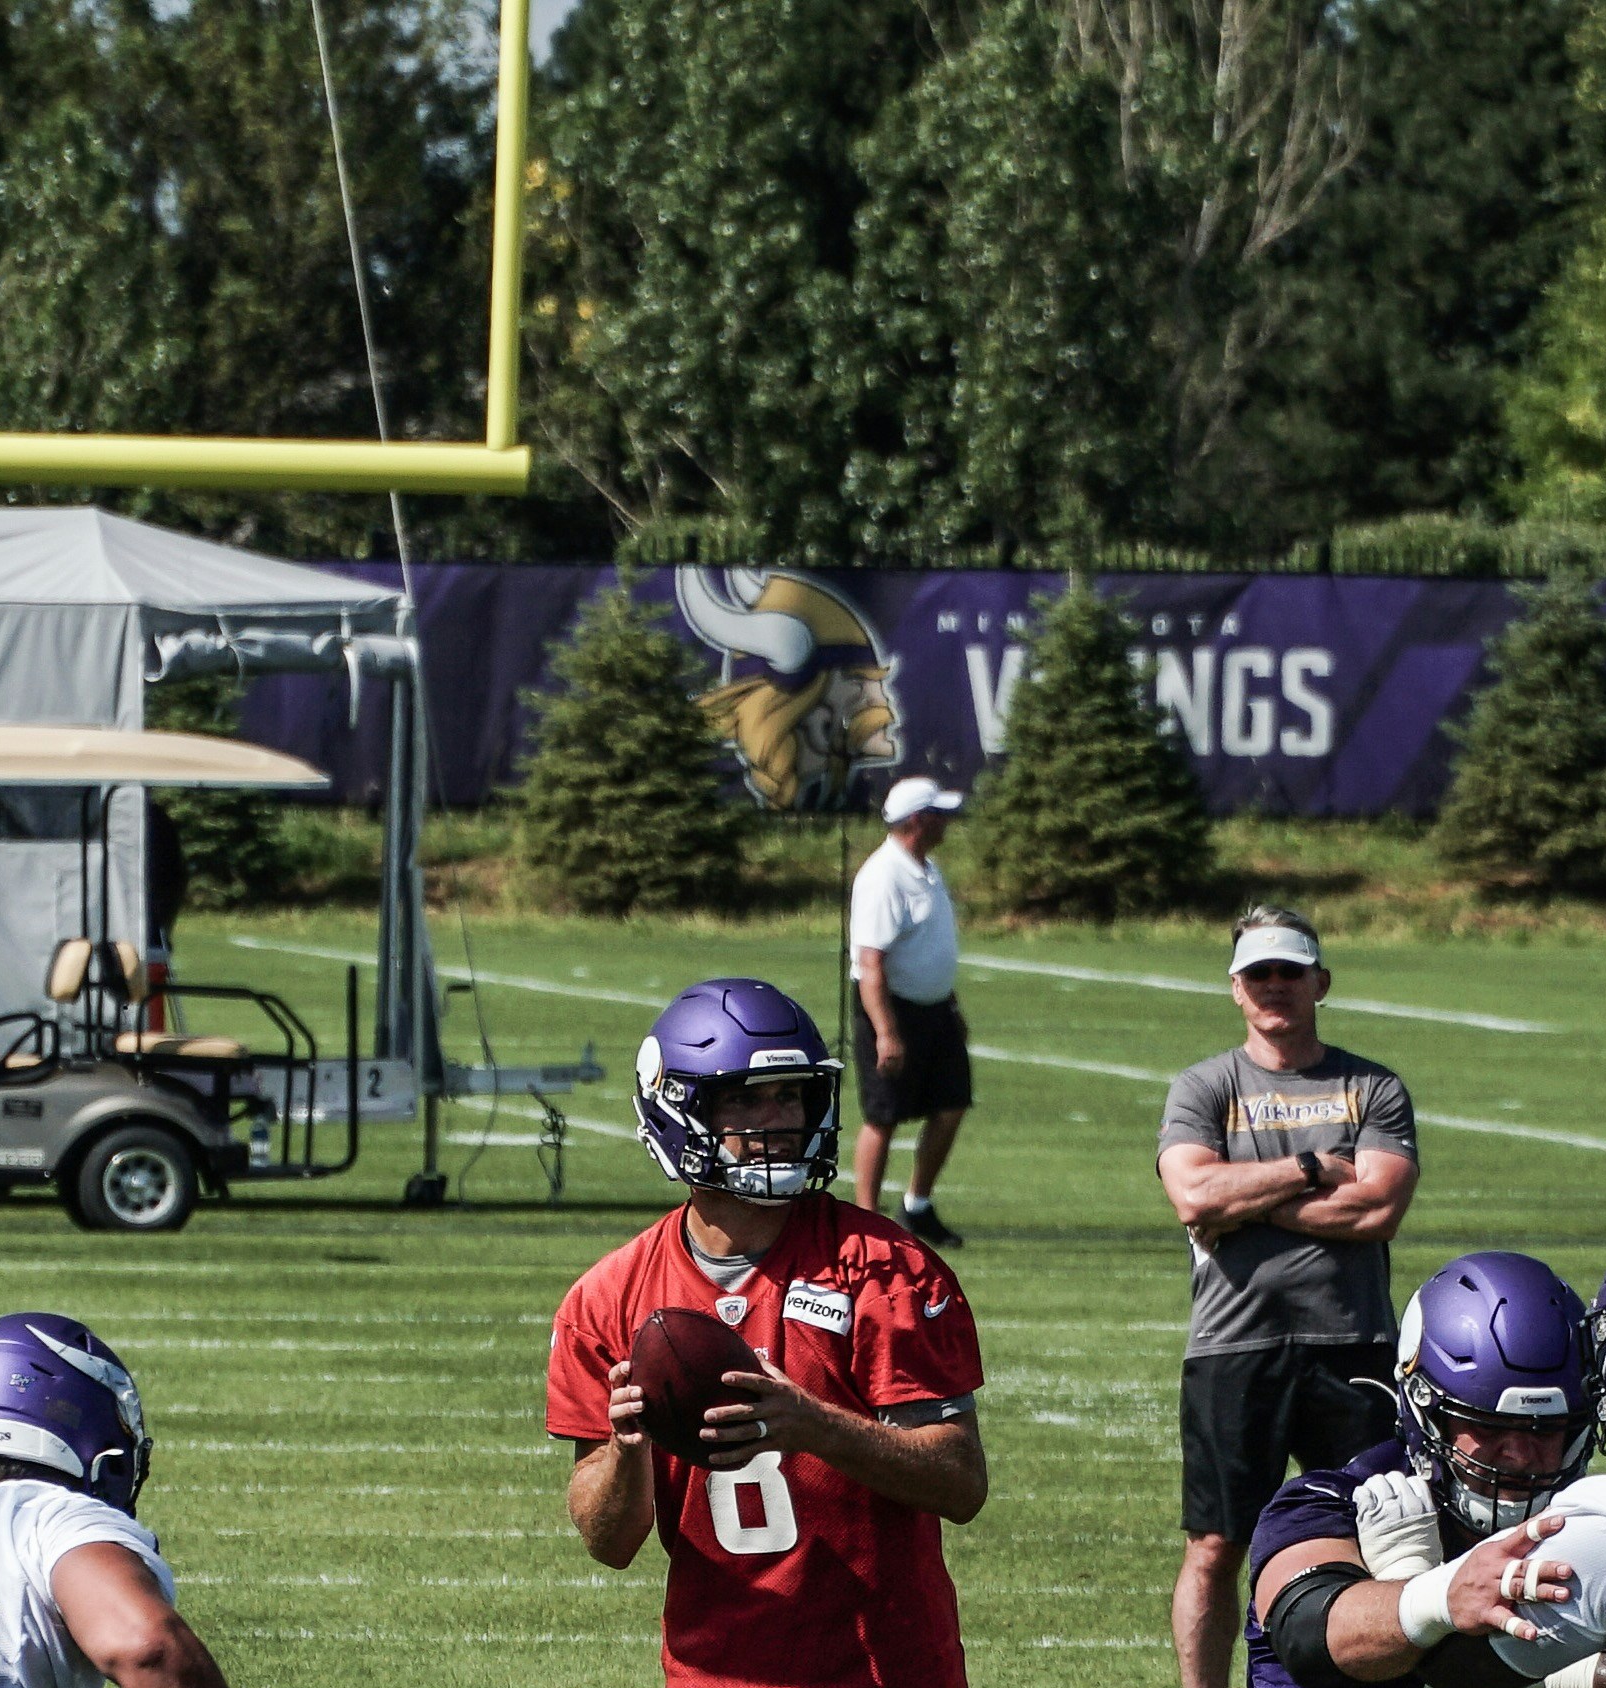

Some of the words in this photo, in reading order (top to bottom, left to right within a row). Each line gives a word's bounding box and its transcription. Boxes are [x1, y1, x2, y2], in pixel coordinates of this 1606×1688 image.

[937, 612, 1241, 636] MINOTA
[965, 645, 1334, 757] VNGS
[368, 1067, 381, 1098] 2
[787, 1295, 844, 1321] verizon
